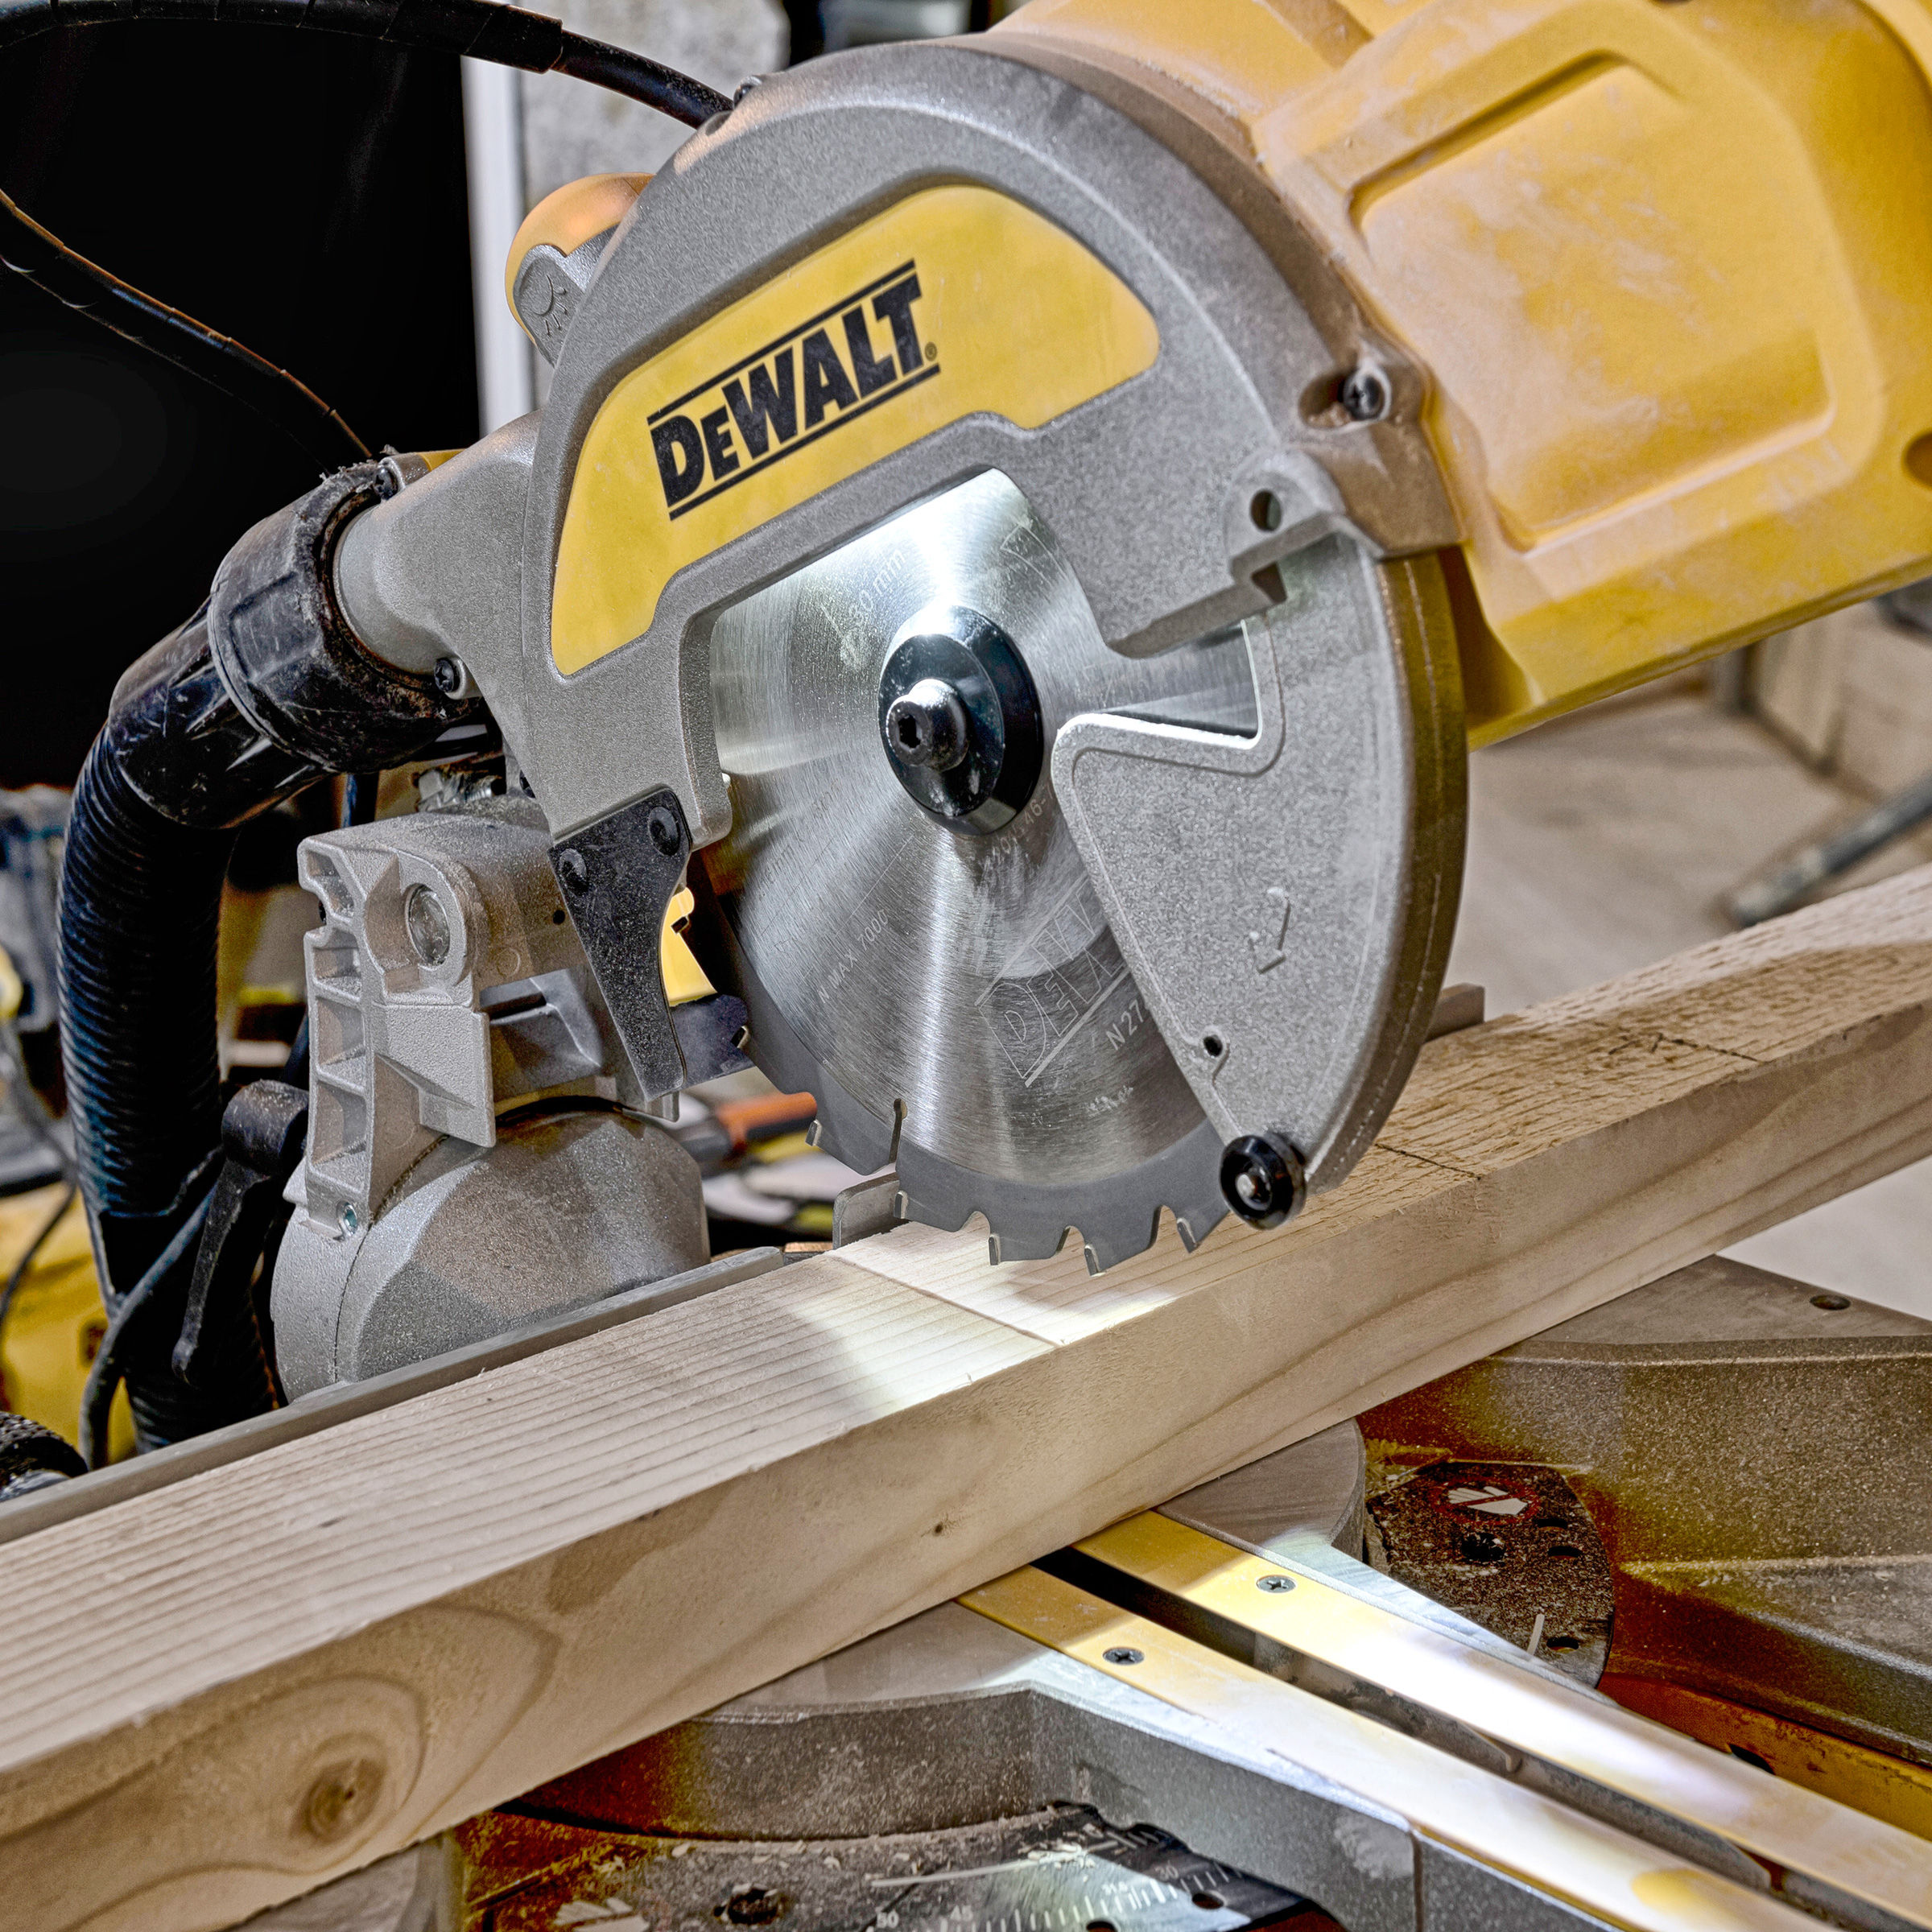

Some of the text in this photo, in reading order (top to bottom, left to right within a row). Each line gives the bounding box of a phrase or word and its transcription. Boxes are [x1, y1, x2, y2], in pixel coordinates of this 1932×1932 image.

[650, 273, 925, 509] DEWALT
[828, 950, 859, 990] MAX
[857, 909, 889, 952] 7000
